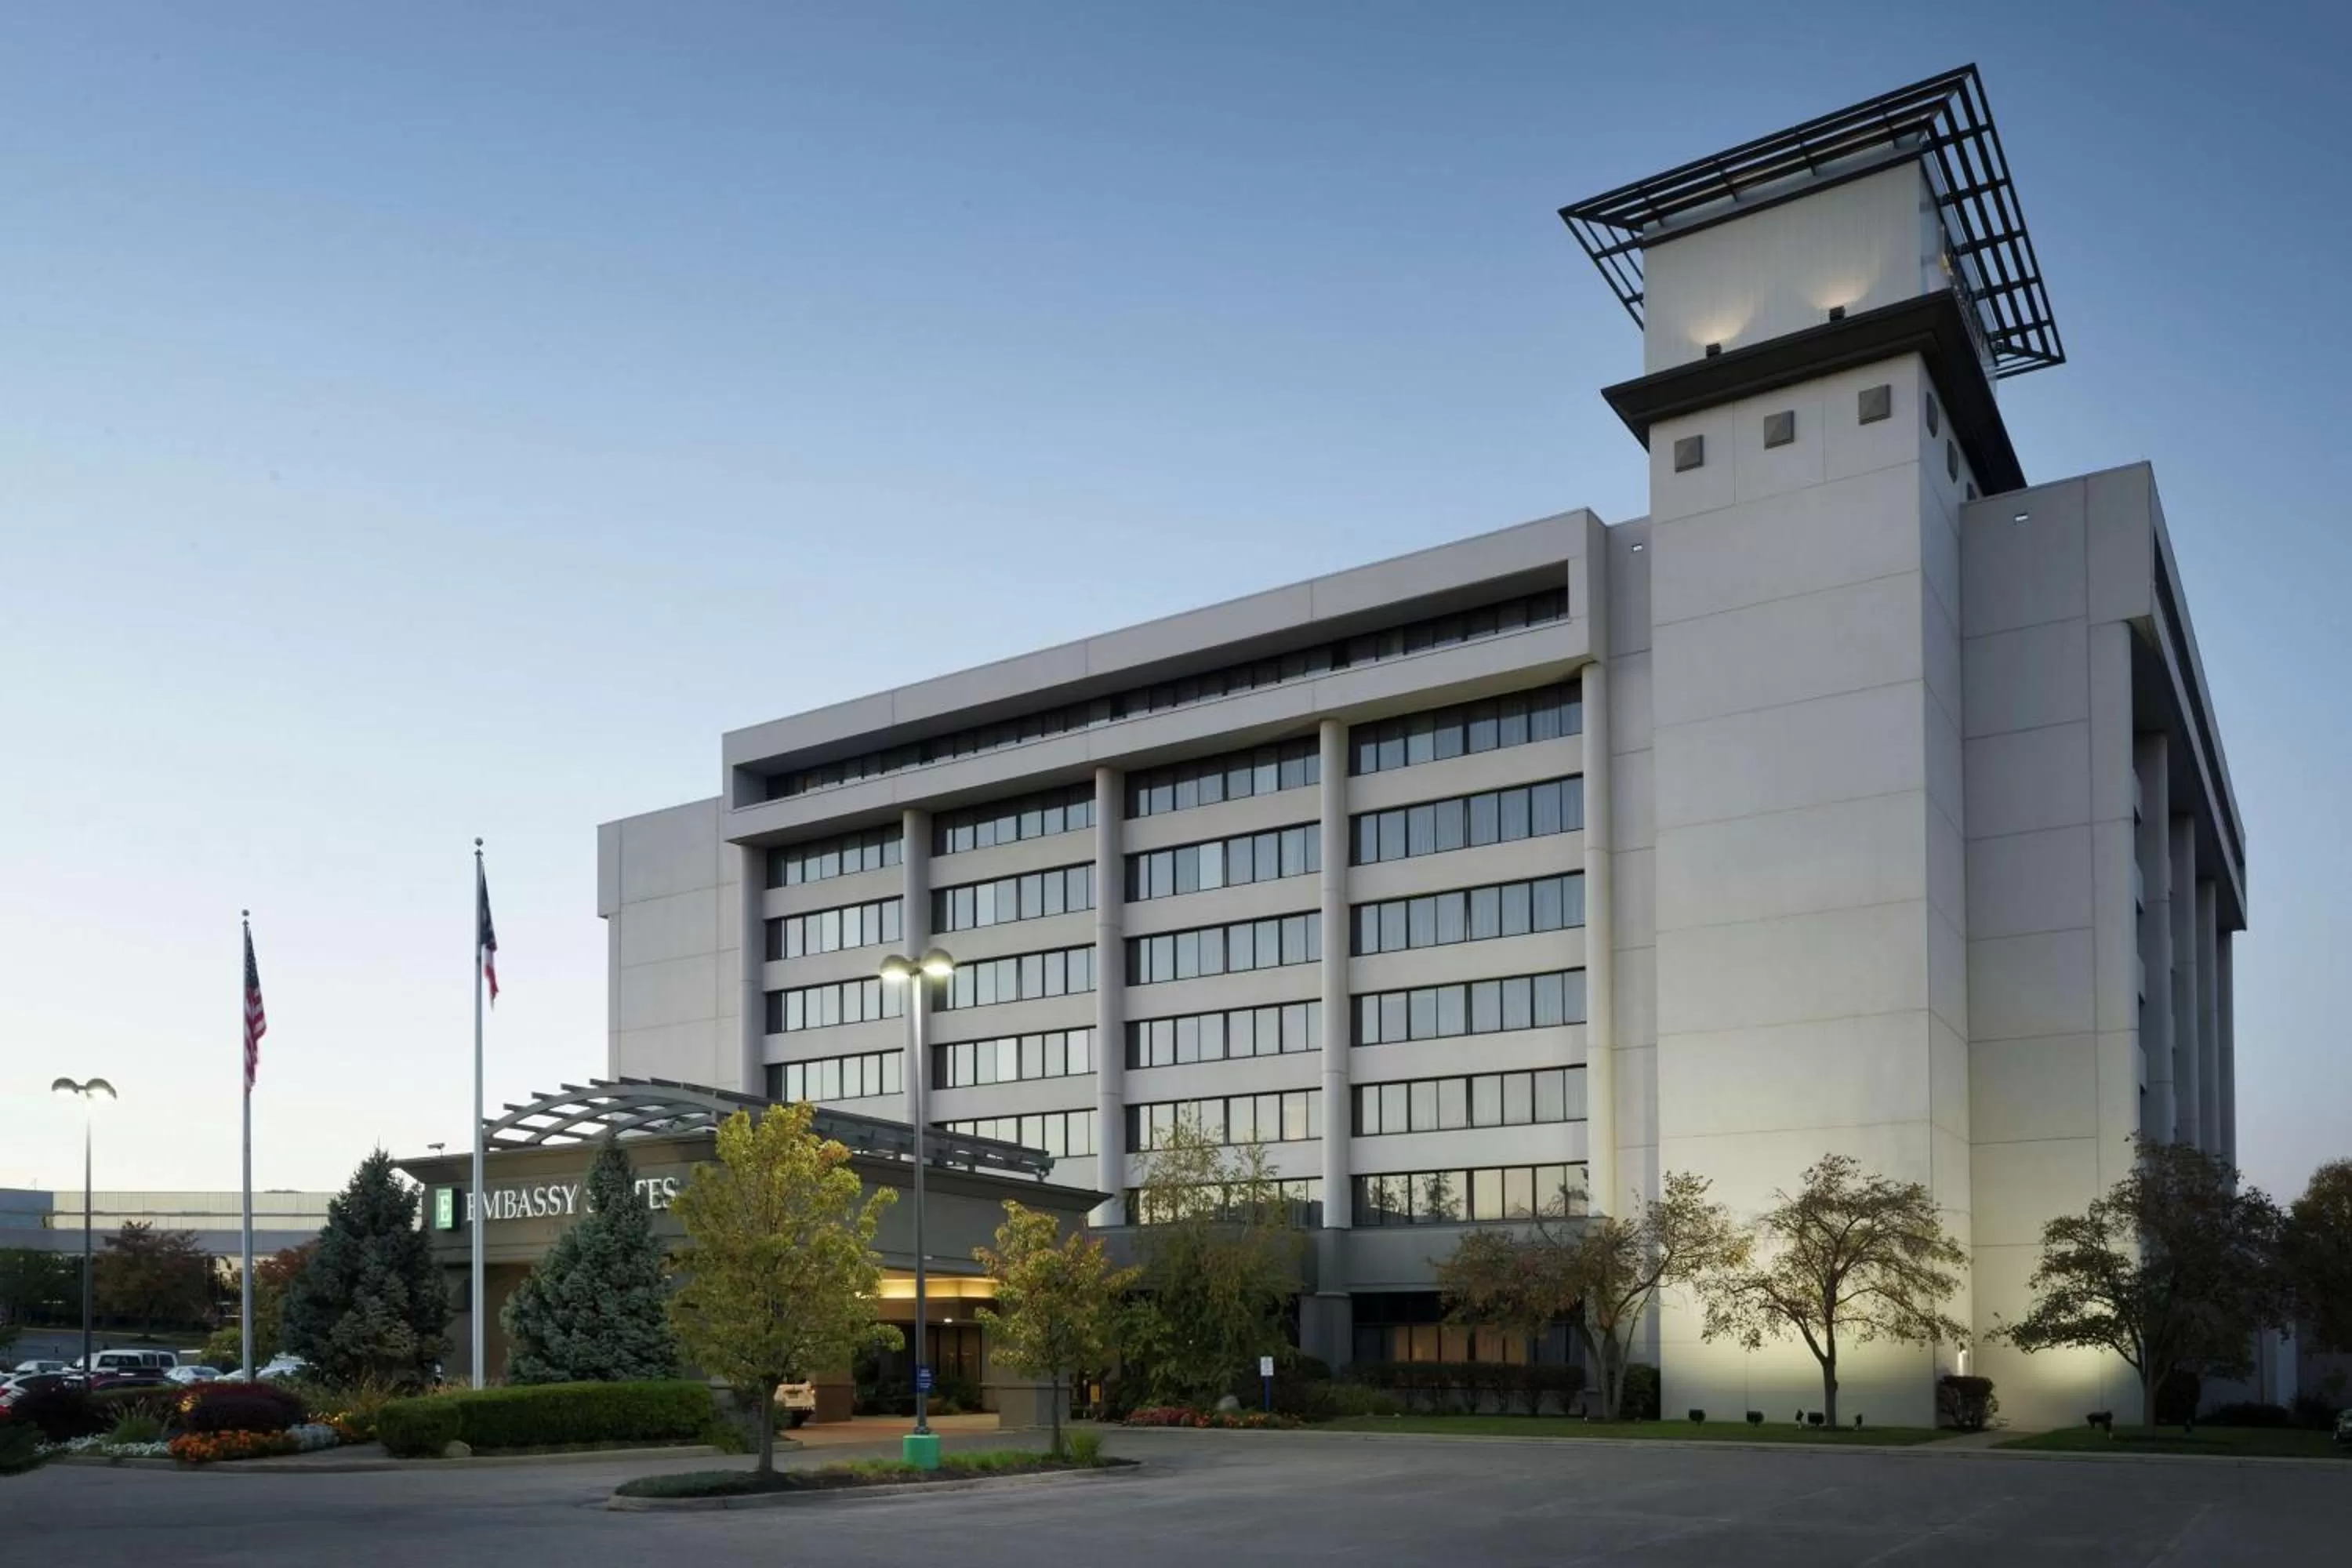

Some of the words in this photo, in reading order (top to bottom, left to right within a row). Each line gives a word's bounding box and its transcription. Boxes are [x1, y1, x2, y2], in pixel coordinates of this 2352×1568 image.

[439, 1195, 450, 1223] E
[466, 1183, 578, 1221] EMBASSY
[586, 1177, 681, 1214] TES
